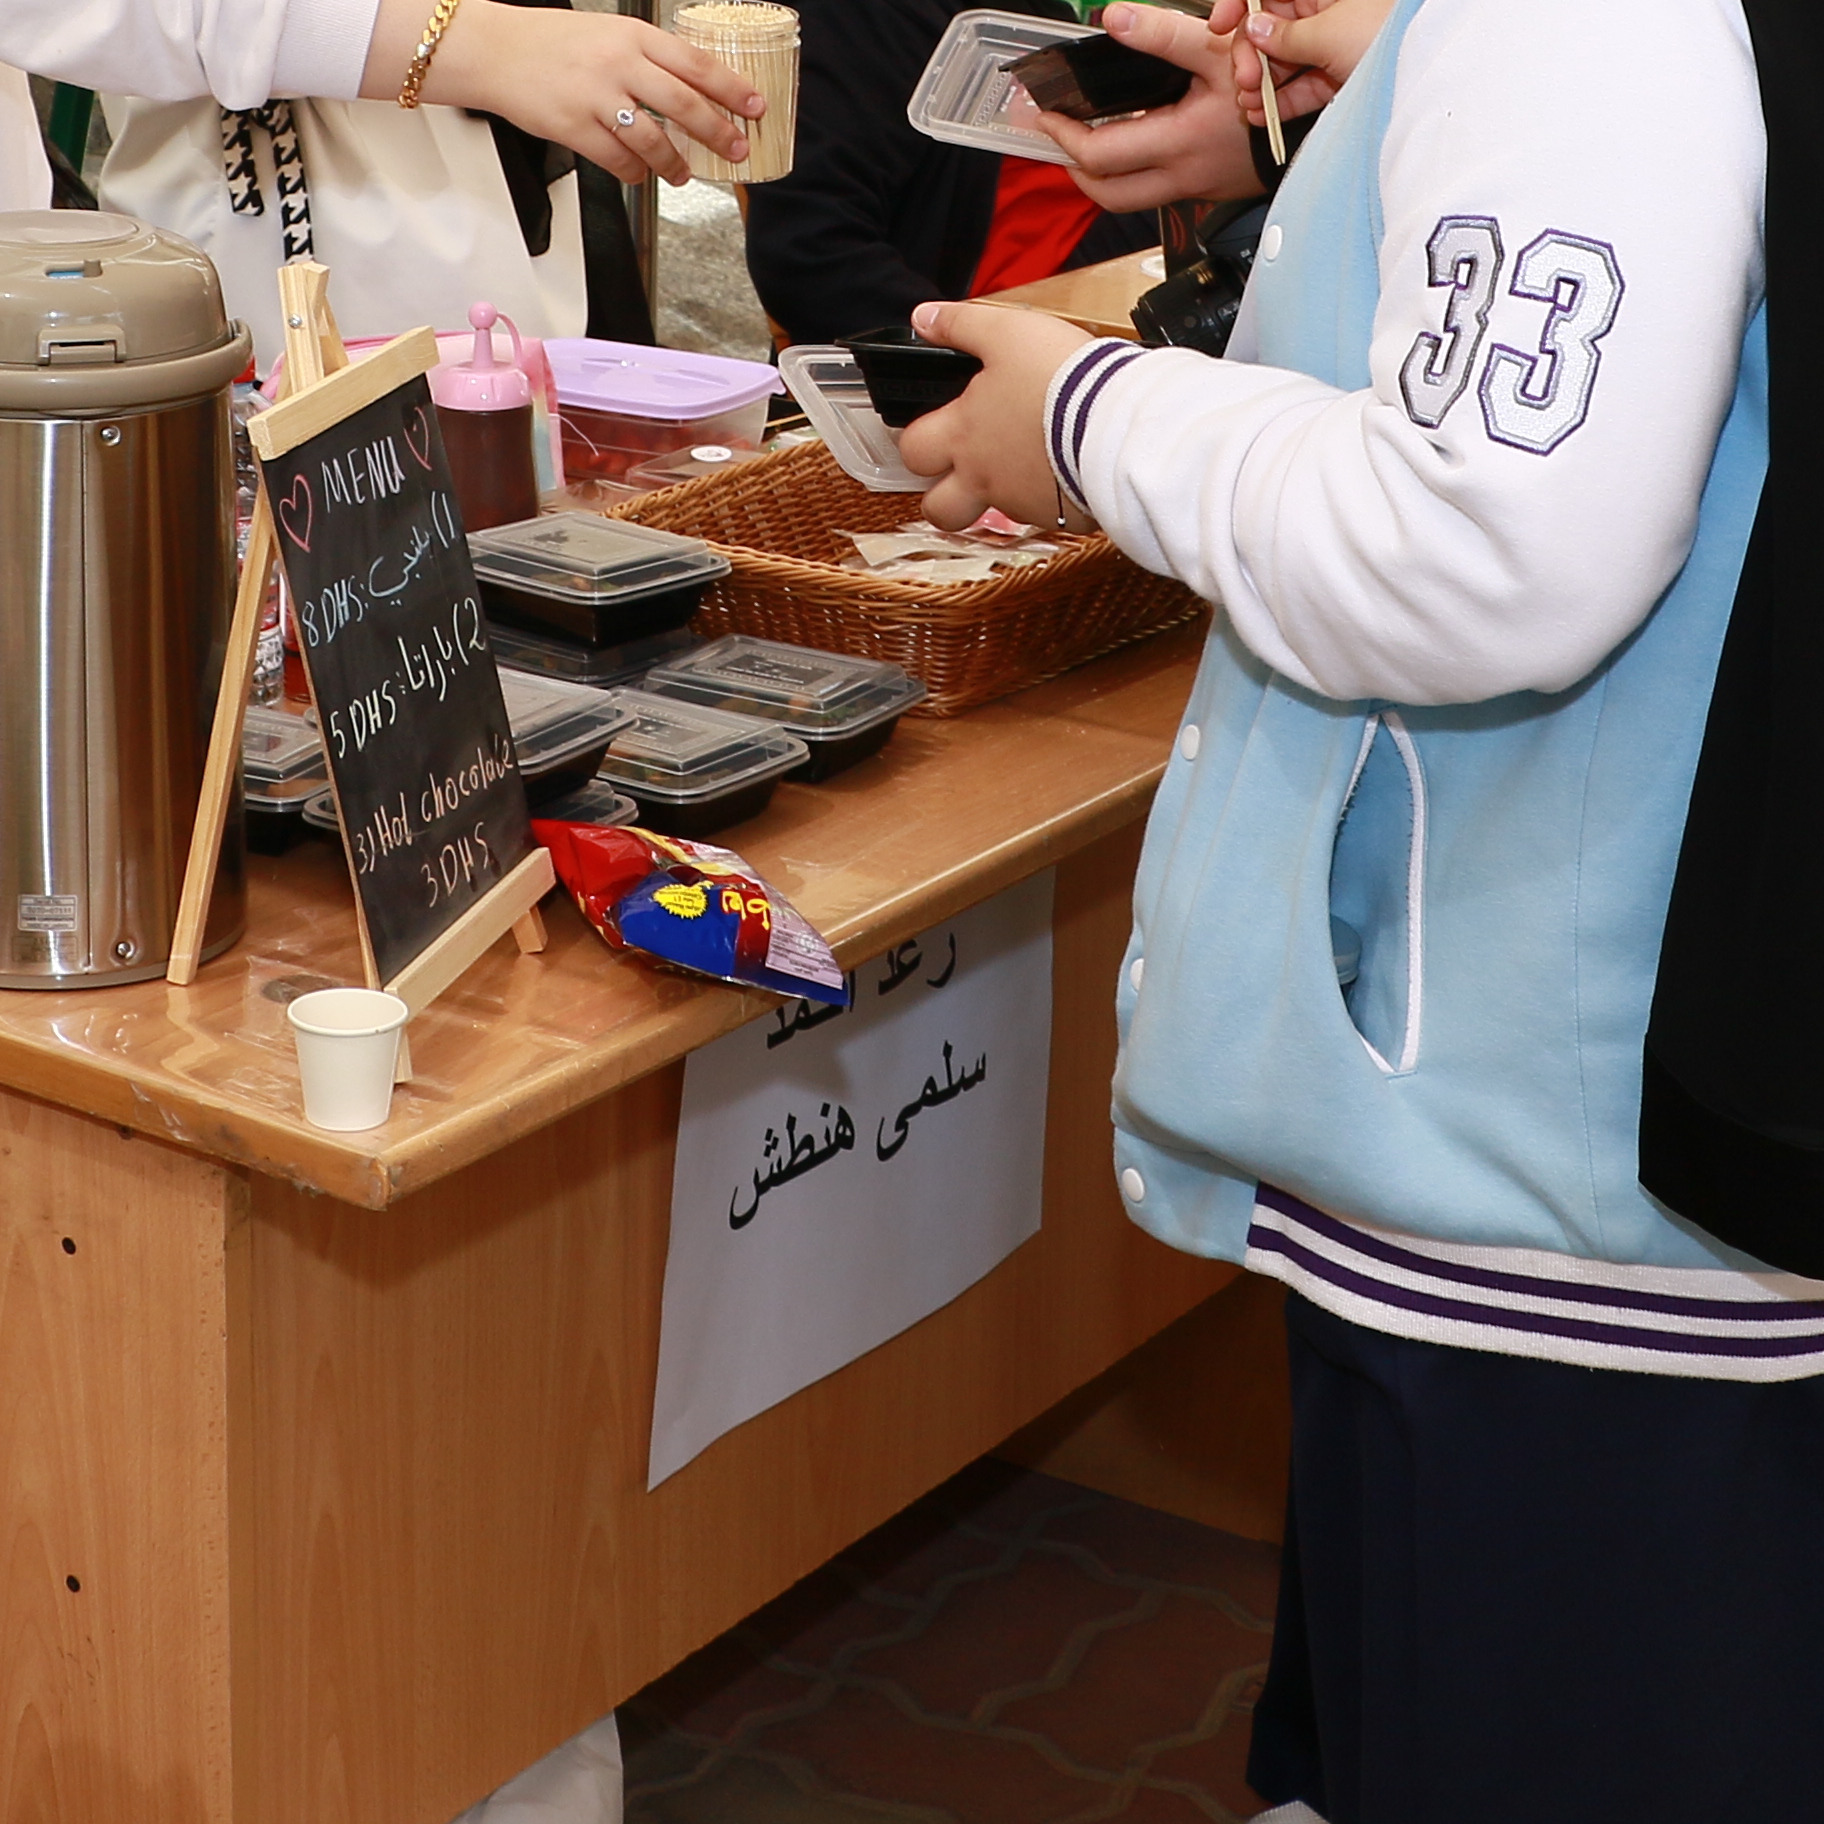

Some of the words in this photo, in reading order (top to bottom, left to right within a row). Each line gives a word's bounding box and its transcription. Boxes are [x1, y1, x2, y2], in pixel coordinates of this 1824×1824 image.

[1398, 213, 1627, 457] 33
[320, 435, 407, 514] MENU
[301, 600, 319, 647] 8
[320, 575, 364, 644] DHS
[329, 710, 346, 759] 5
[348, 679, 397, 753] DHS
[420, 732, 514, 823] chocolate
[420, 863, 439, 909] 3
[439, 821, 489, 897] DHS
[876, 1038, 988, 1162] سلمى
[728, 1100, 858, 1232] هنطش
